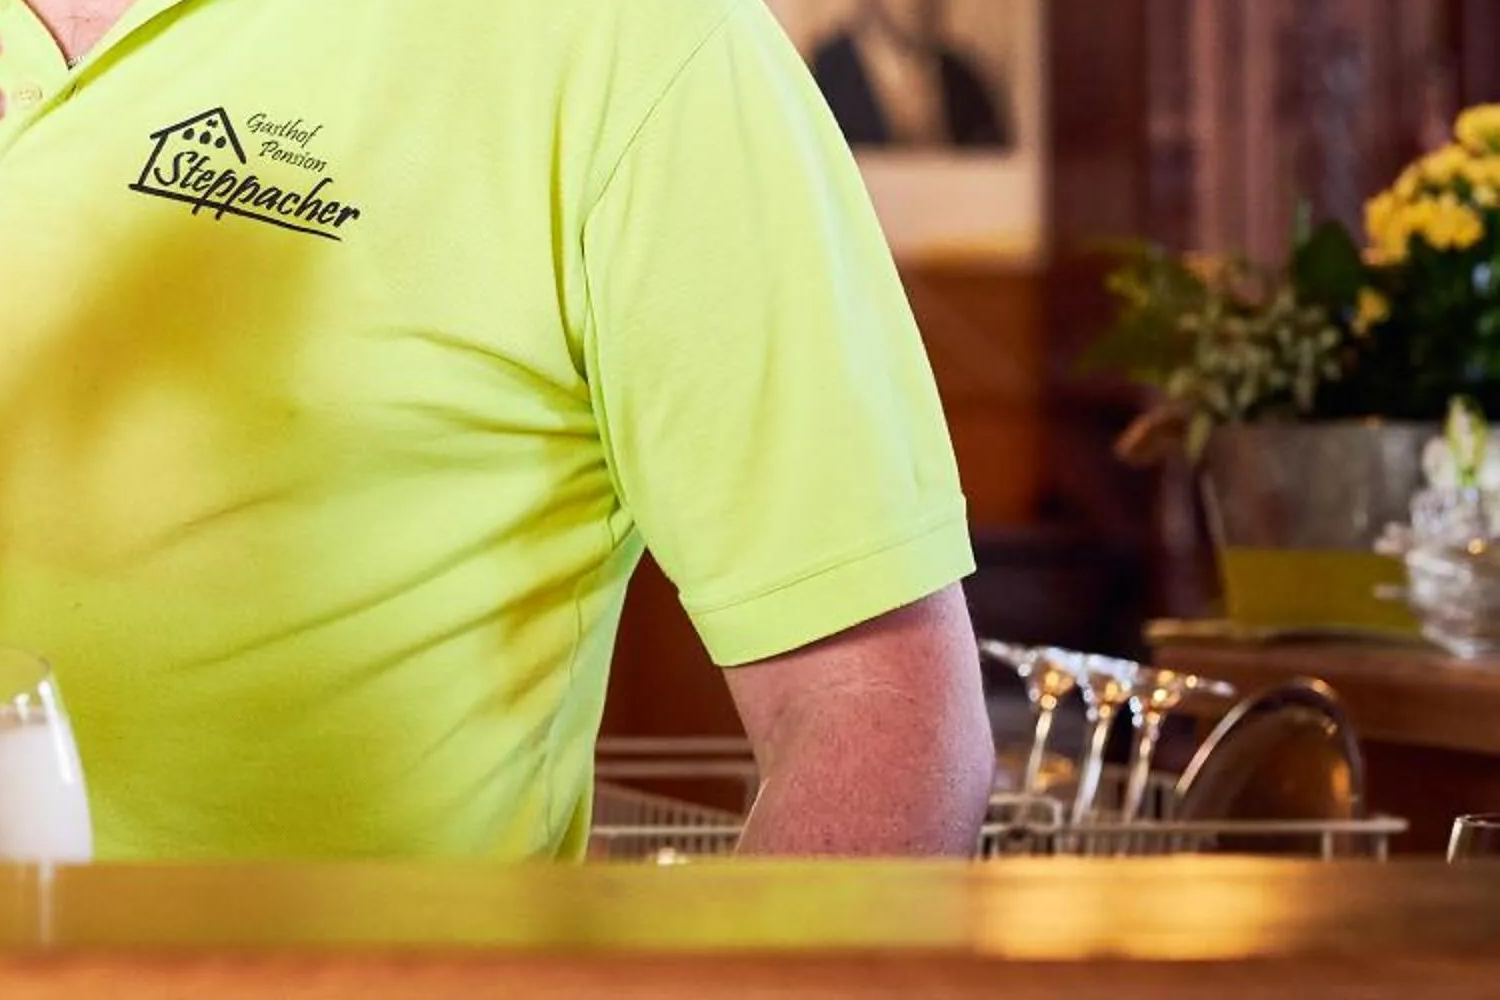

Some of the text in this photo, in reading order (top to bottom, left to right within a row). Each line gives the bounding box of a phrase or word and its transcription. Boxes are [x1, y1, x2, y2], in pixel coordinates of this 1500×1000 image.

[246, 112, 323, 148] Gasthof
[260, 142, 327, 173] Pension
[154, 151, 361, 228] Steppacher
